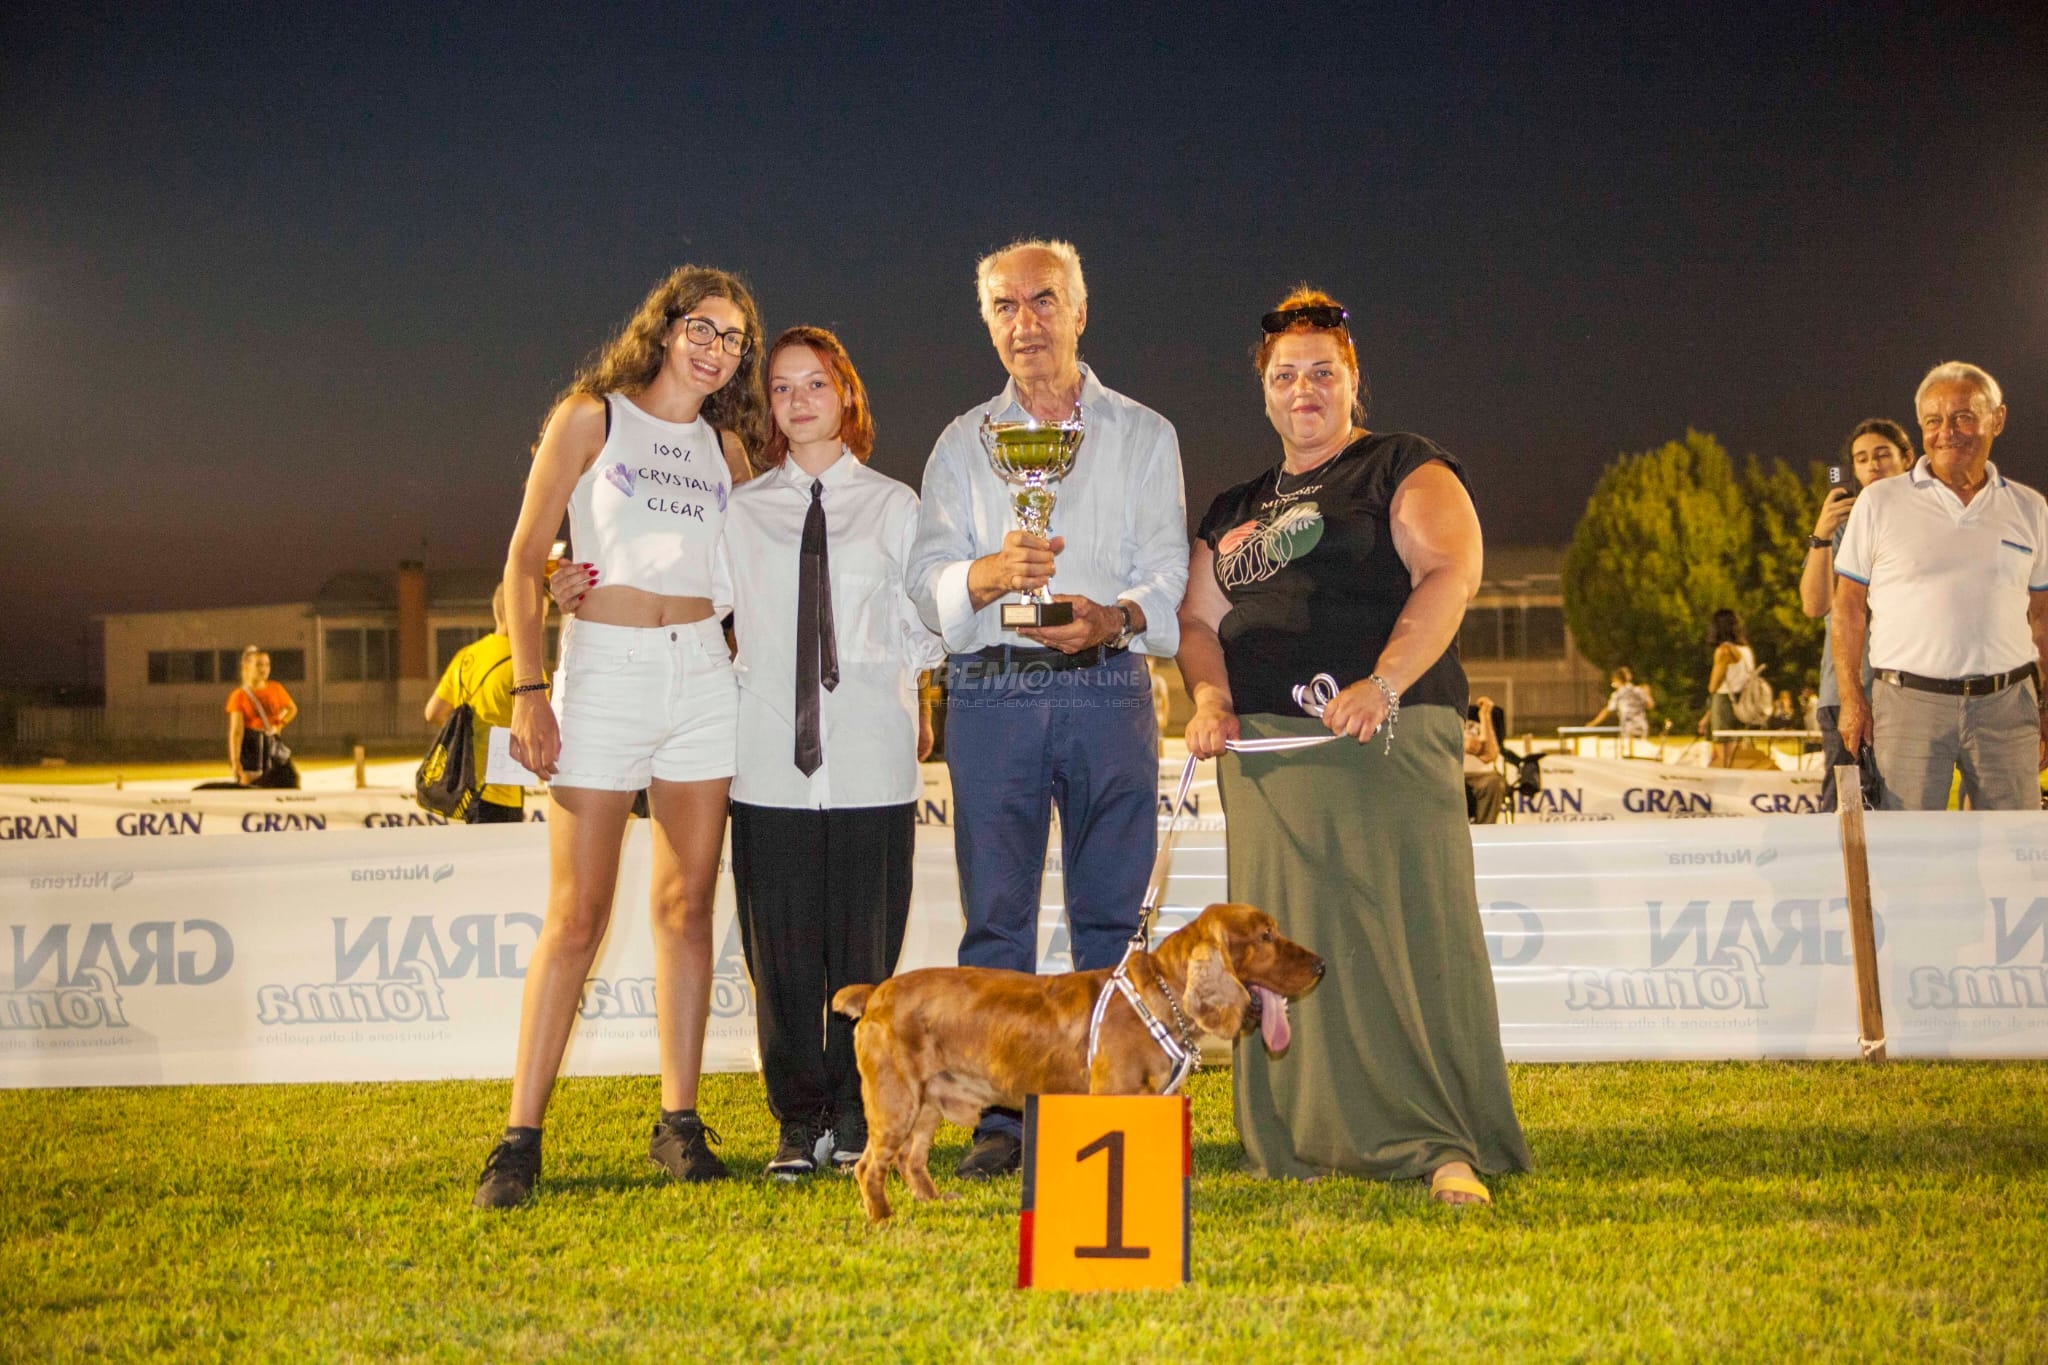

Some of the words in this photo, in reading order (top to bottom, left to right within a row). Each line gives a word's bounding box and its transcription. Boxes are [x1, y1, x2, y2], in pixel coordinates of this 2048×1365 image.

[654, 443, 691, 463] 100%
[638, 467, 713, 492] CRYSTAL
[647, 497, 704, 522] CLEAR
[1623, 788, 1711, 813] GRAN
[0, 814, 77, 840] GRAN
[116, 812, 203, 836] GRAN
[242, 811, 326, 833] GRAN
[1075, 1130, 1150, 1259] 1
